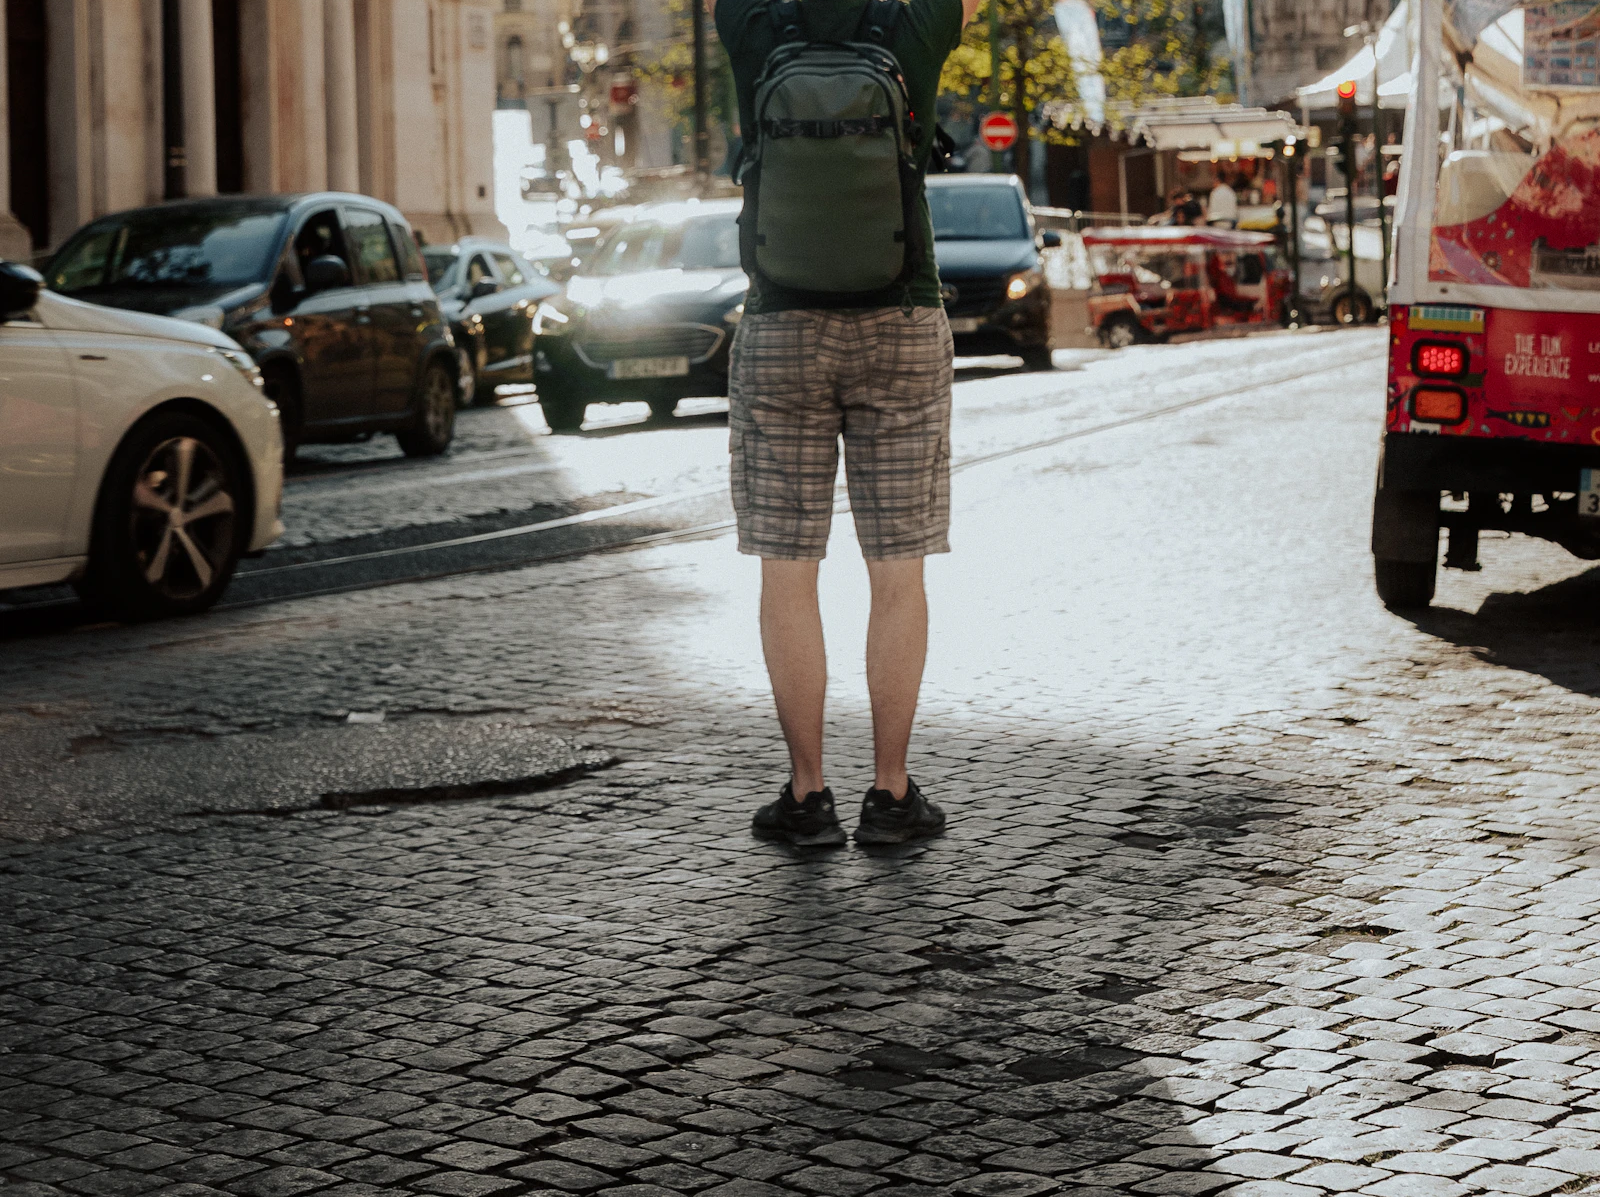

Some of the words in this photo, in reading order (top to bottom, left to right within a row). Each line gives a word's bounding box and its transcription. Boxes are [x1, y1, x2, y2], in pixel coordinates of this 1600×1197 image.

[1515, 333, 1535, 355] THE
[1541, 334, 1562, 356] TUK
[1504, 353, 1570, 379] EXPERIENCE
